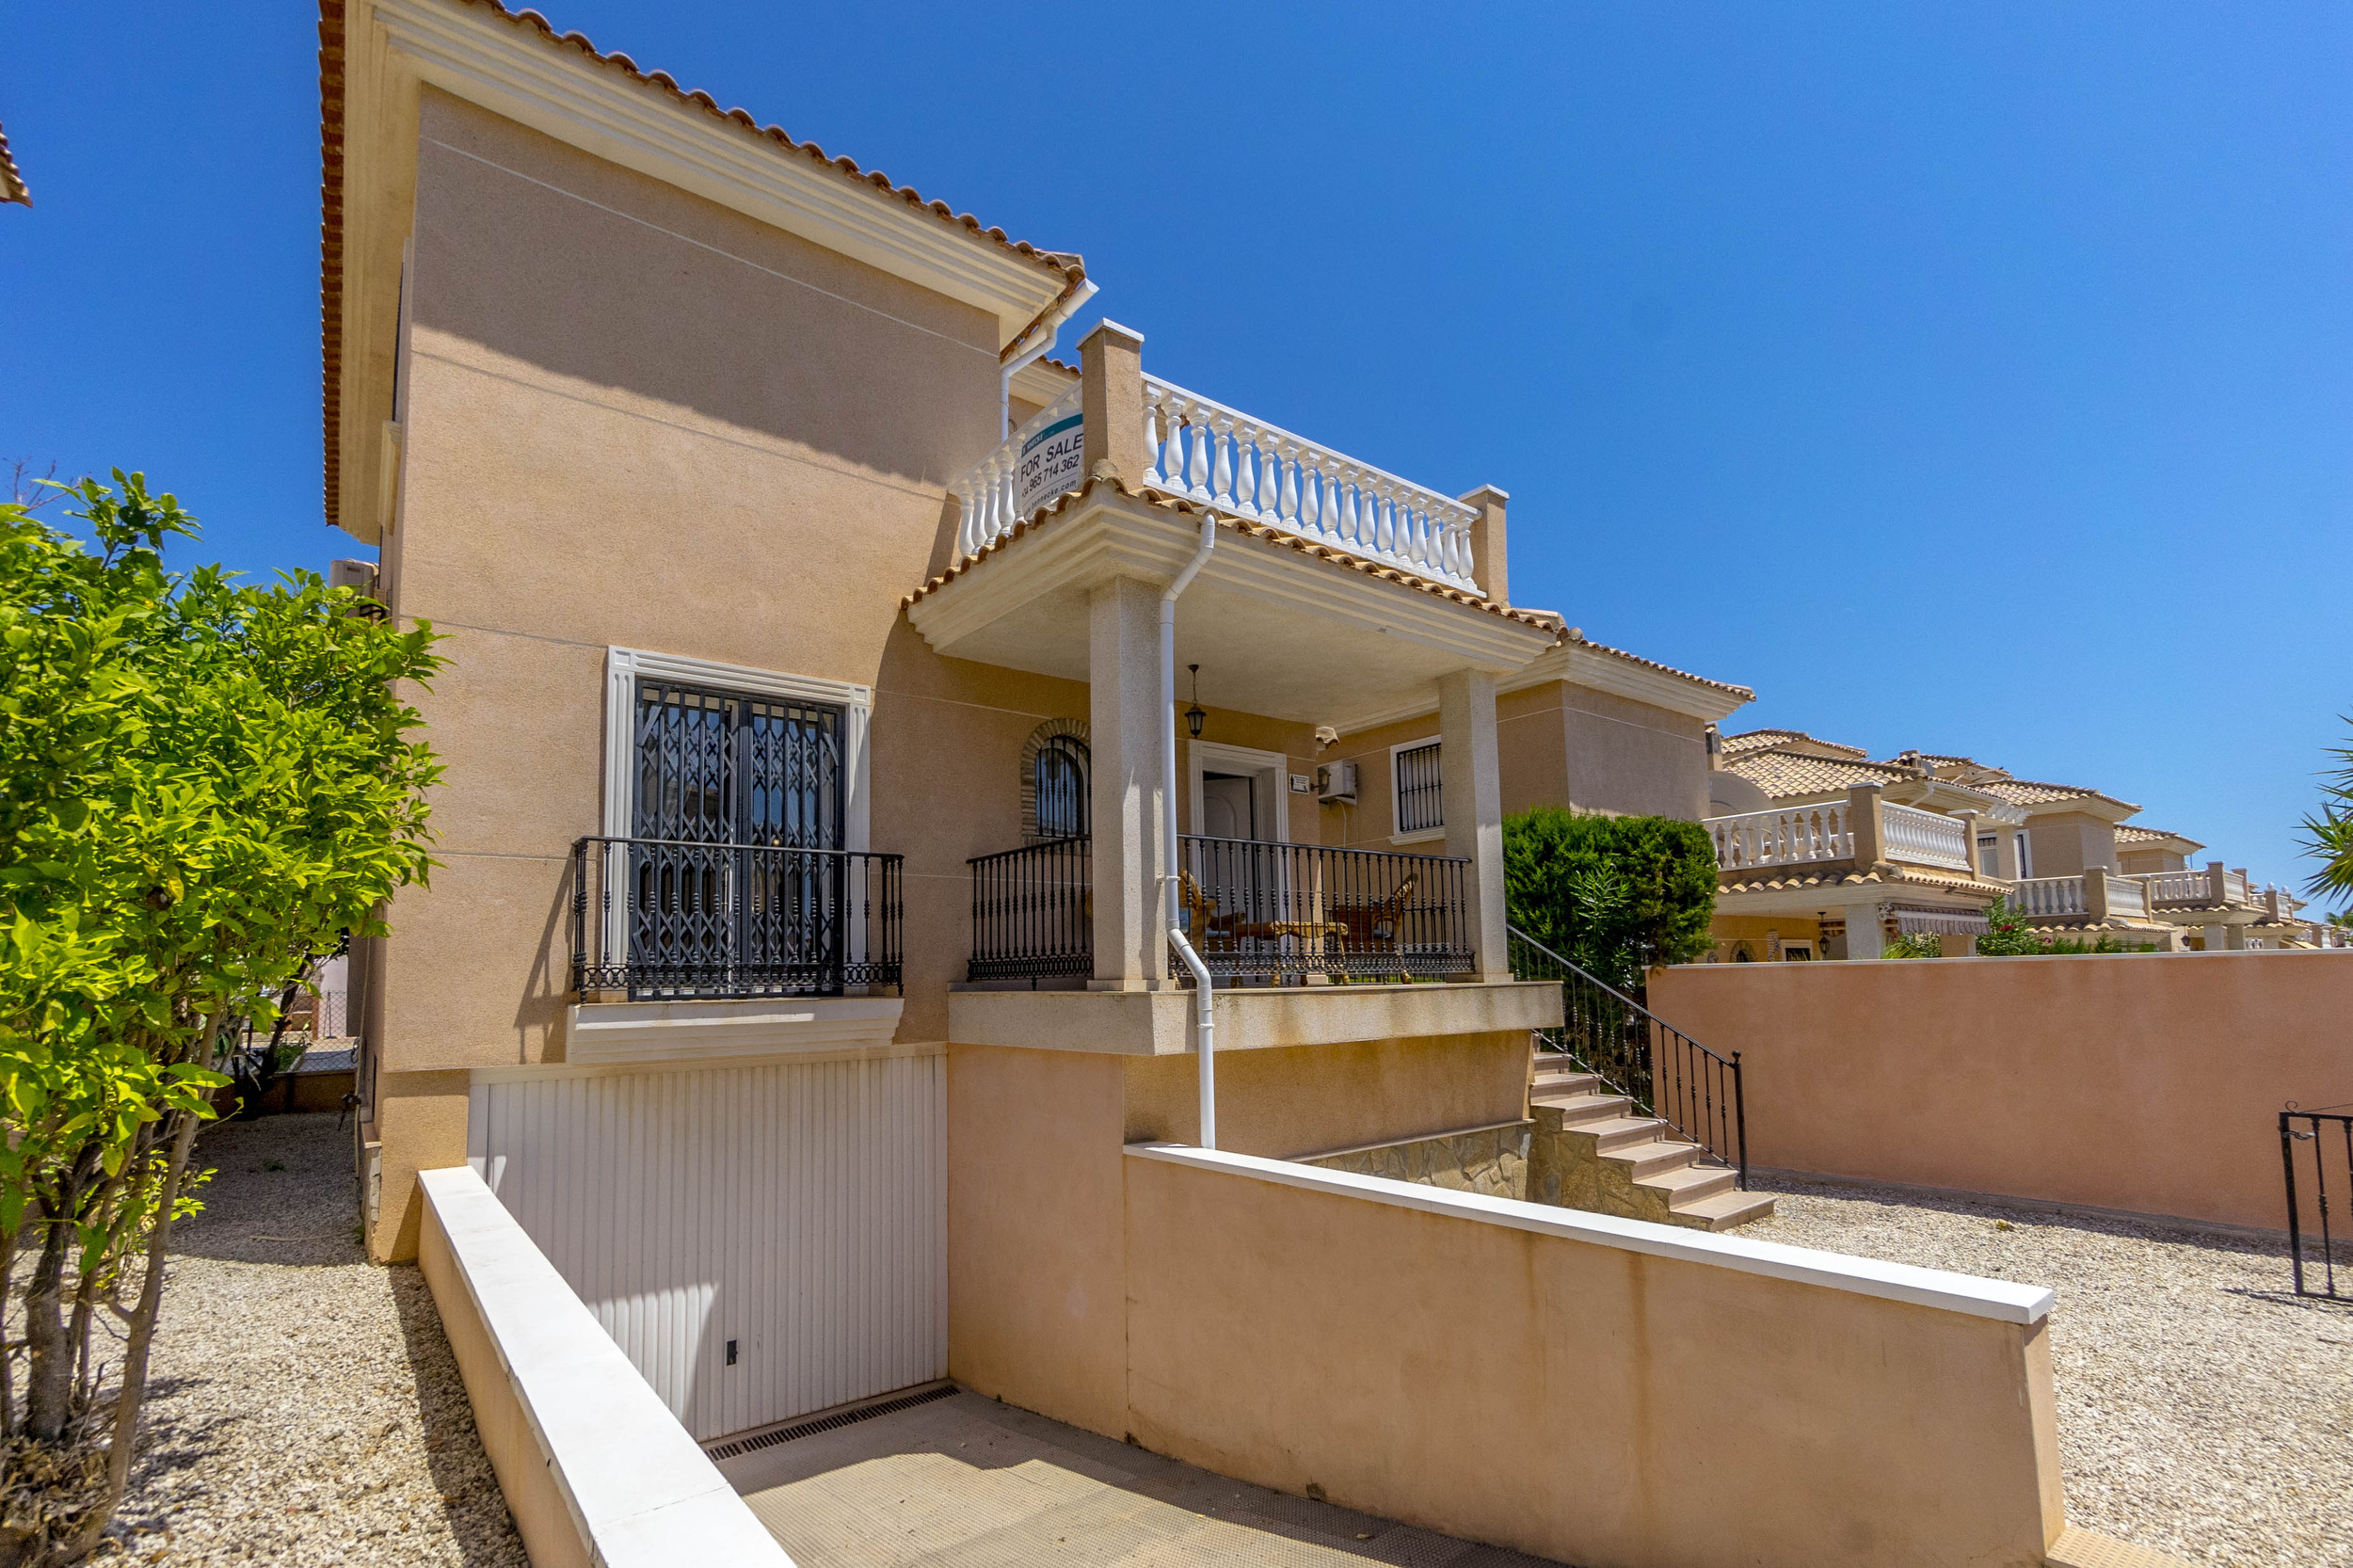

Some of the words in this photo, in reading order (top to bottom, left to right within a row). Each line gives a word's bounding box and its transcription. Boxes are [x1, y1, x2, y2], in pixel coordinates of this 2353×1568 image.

[1020, 454, 1040, 482] FOR
[1046, 433, 1084, 463] SALE
[1029, 472, 1042, 491] 965
[1044, 462, 1059, 482] 714
[1061, 455, 1080, 472] 362
[1023, 480, 1077, 515] bennecke.com
